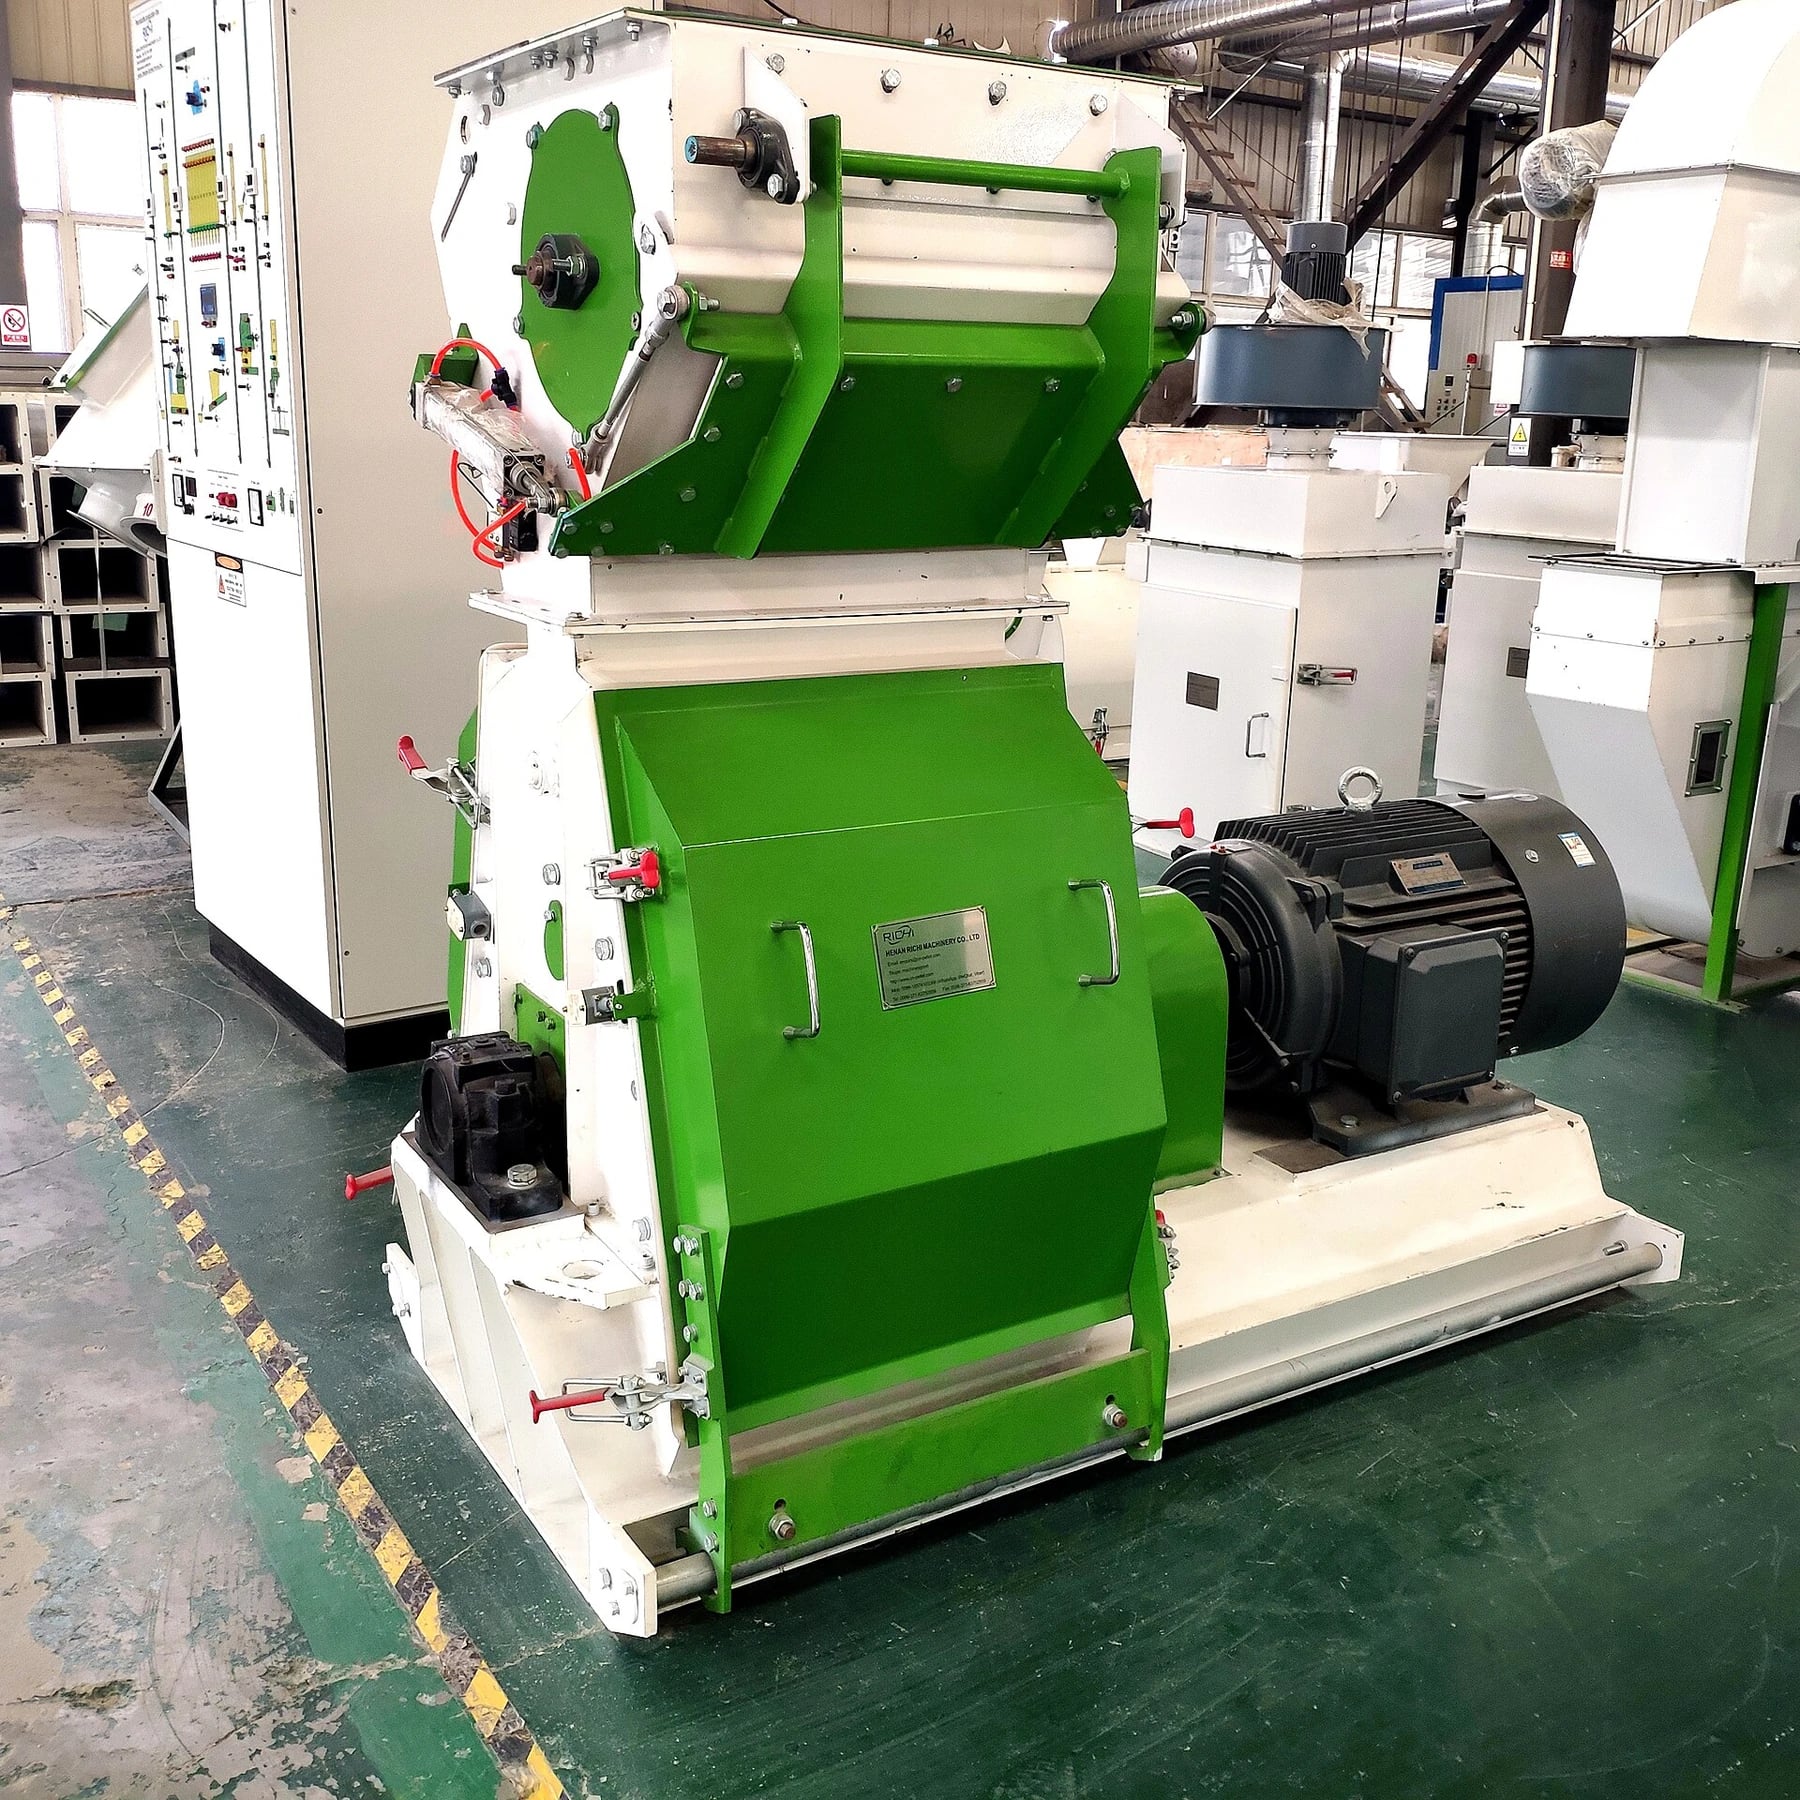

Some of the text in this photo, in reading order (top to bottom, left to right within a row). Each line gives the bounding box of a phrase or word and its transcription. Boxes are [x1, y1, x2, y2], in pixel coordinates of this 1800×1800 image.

[143, 503, 153, 516] 10
[885, 947, 907, 957] HENAN
[906, 944, 922, 953] RICHI
[923, 938, 956, 950] MACHINERY
